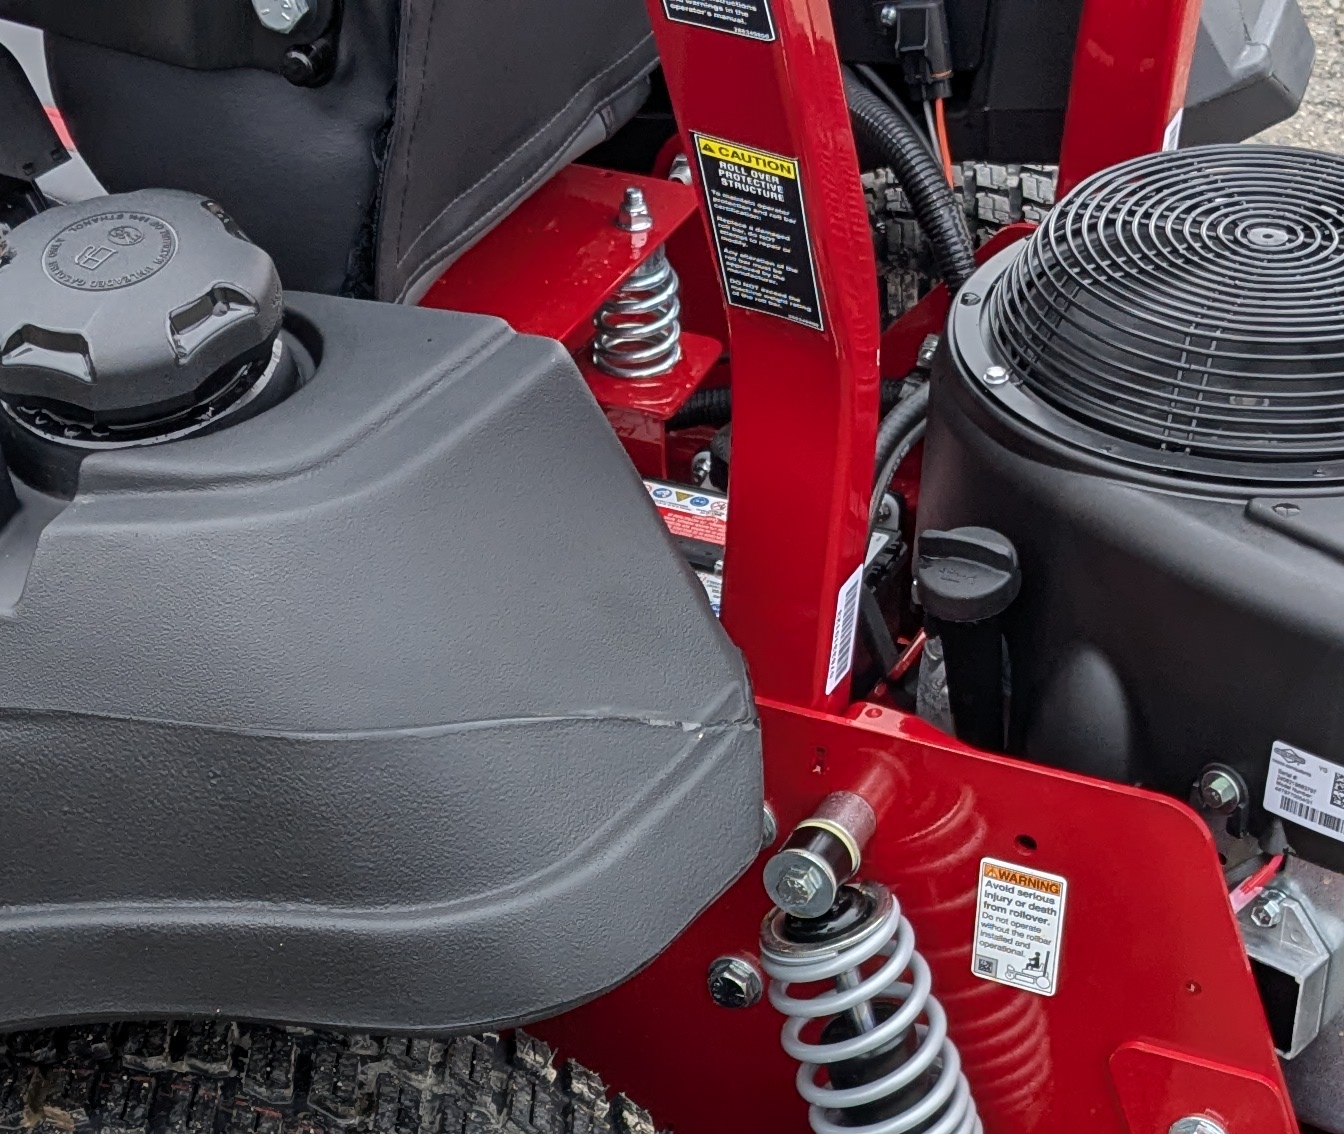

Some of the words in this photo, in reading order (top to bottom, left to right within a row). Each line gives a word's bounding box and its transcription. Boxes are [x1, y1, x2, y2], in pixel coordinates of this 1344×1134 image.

[670, 3, 712, 16] operator's
[714, 13, 747, 25] manual.
[718, 147, 791, 174] CAUTION
[719, 161, 747, 175] ROLL
[751, 170, 779, 184] OVER
[719, 169, 784, 193] PROTECTIVE
[721, 178, 784, 202] STRUCTURE
[985, 880, 1014, 894] Avoid
[1017, 888, 1055, 905] serious
[999, 869, 1060, 894] WARNING
[983, 901, 1007, 914] from
[1009, 910, 1050, 926] rollover.
[1015, 899, 1026, 908] or
[1028, 901, 1057, 917] death
[981, 921, 1010, 935] without
[1011, 928, 1025, 939] the
[1026, 933, 1051, 946] rollbar
[982, 911, 994, 920] Do
[996, 917, 1009, 925] not
[1011, 920, 1041, 934] operate
[979, 939, 1026, 958] operational.
[980, 930, 1013, 945] installed
[1015, 940, 1031, 950] and
